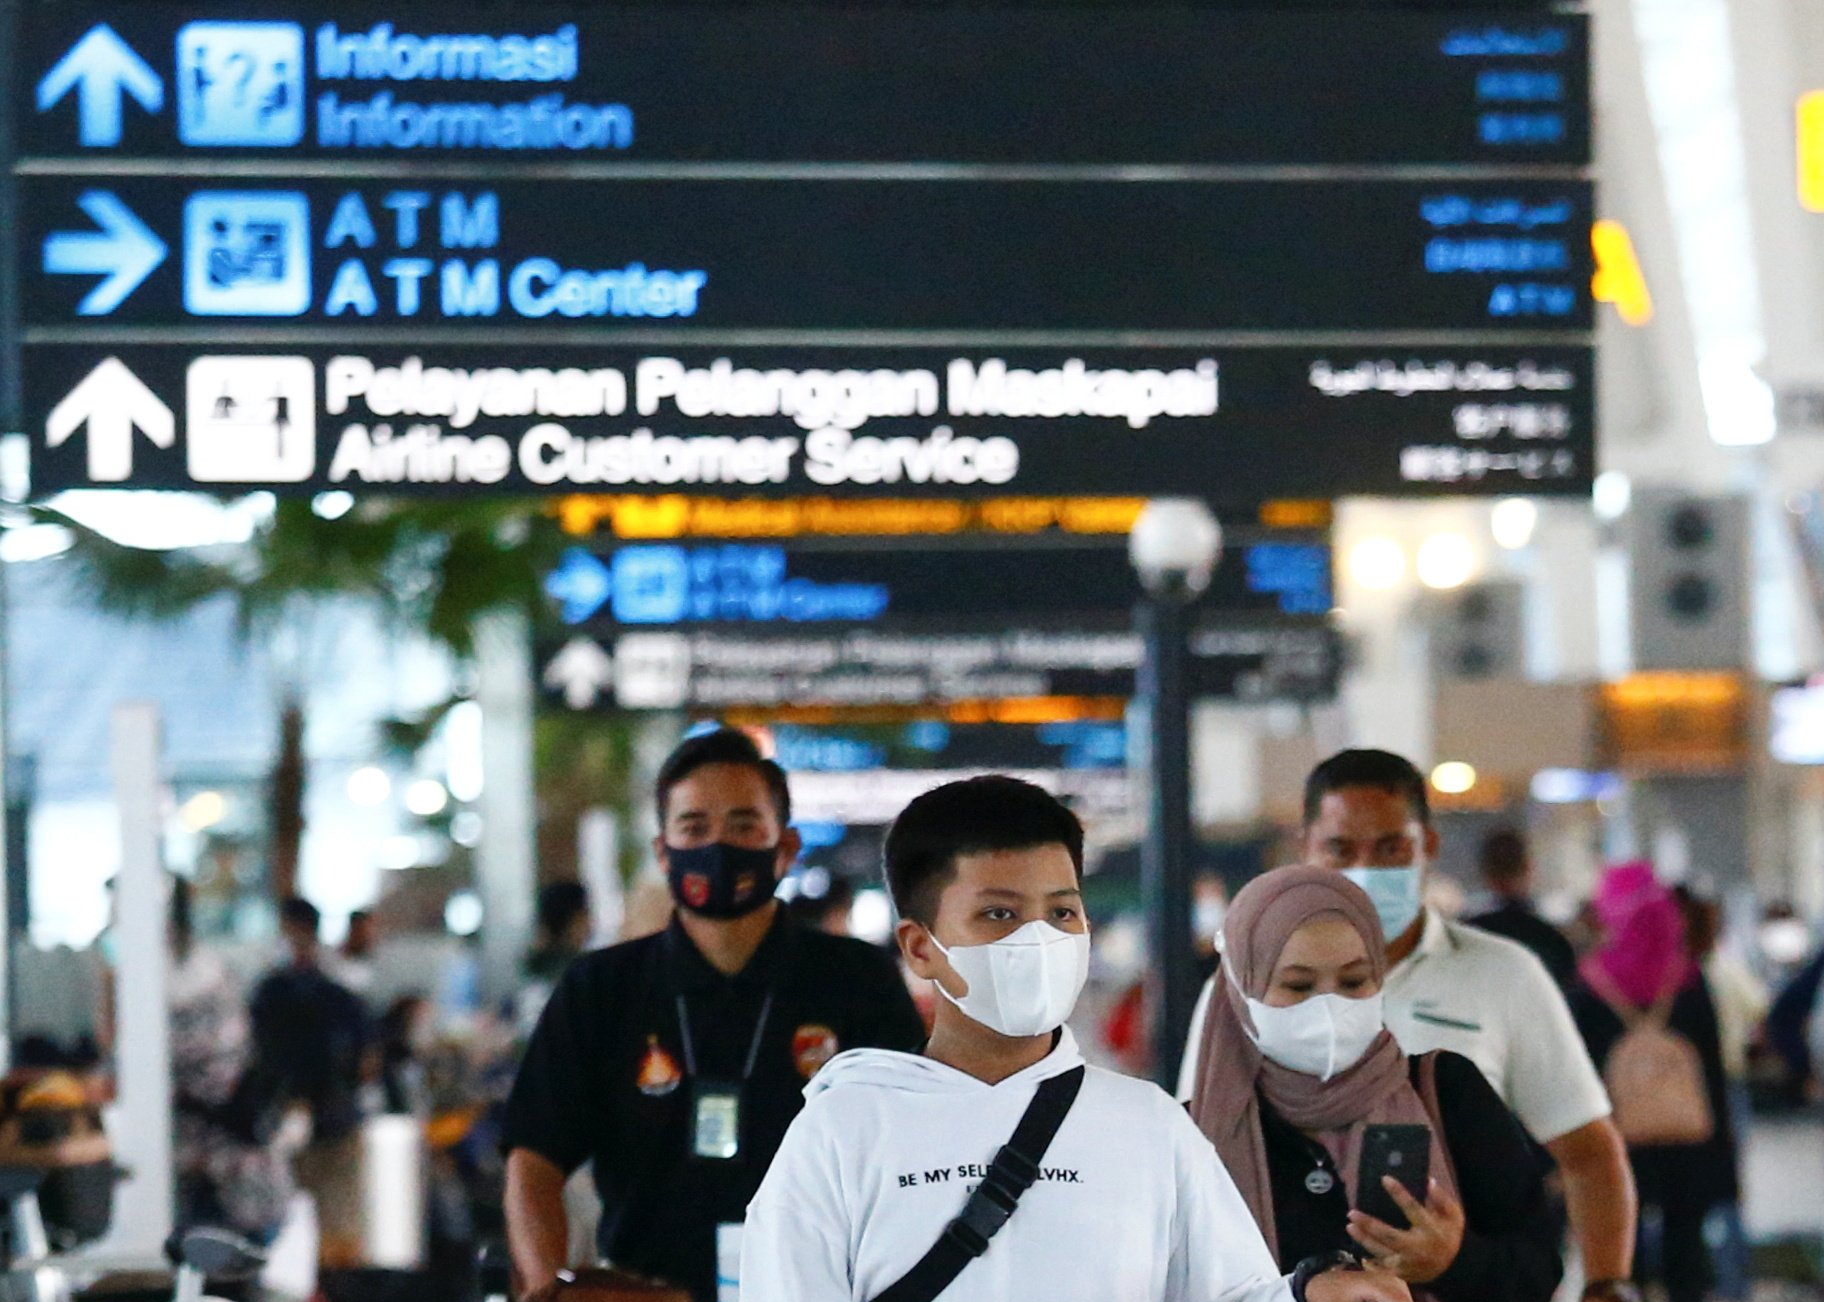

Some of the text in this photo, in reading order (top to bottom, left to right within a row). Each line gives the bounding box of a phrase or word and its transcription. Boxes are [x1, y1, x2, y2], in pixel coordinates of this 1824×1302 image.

[315, 22, 578, 82] Informasi
[316, 93, 633, 150] Information
[508, 256, 707, 318] Center
[326, 356, 1218, 431] Pelayanan Pelanggan Maskapai
[330, 422, 1019, 484] Airline Customer Service
[899, 1173, 917, 1187] BE
[925, 1169, 951, 1183] MY
